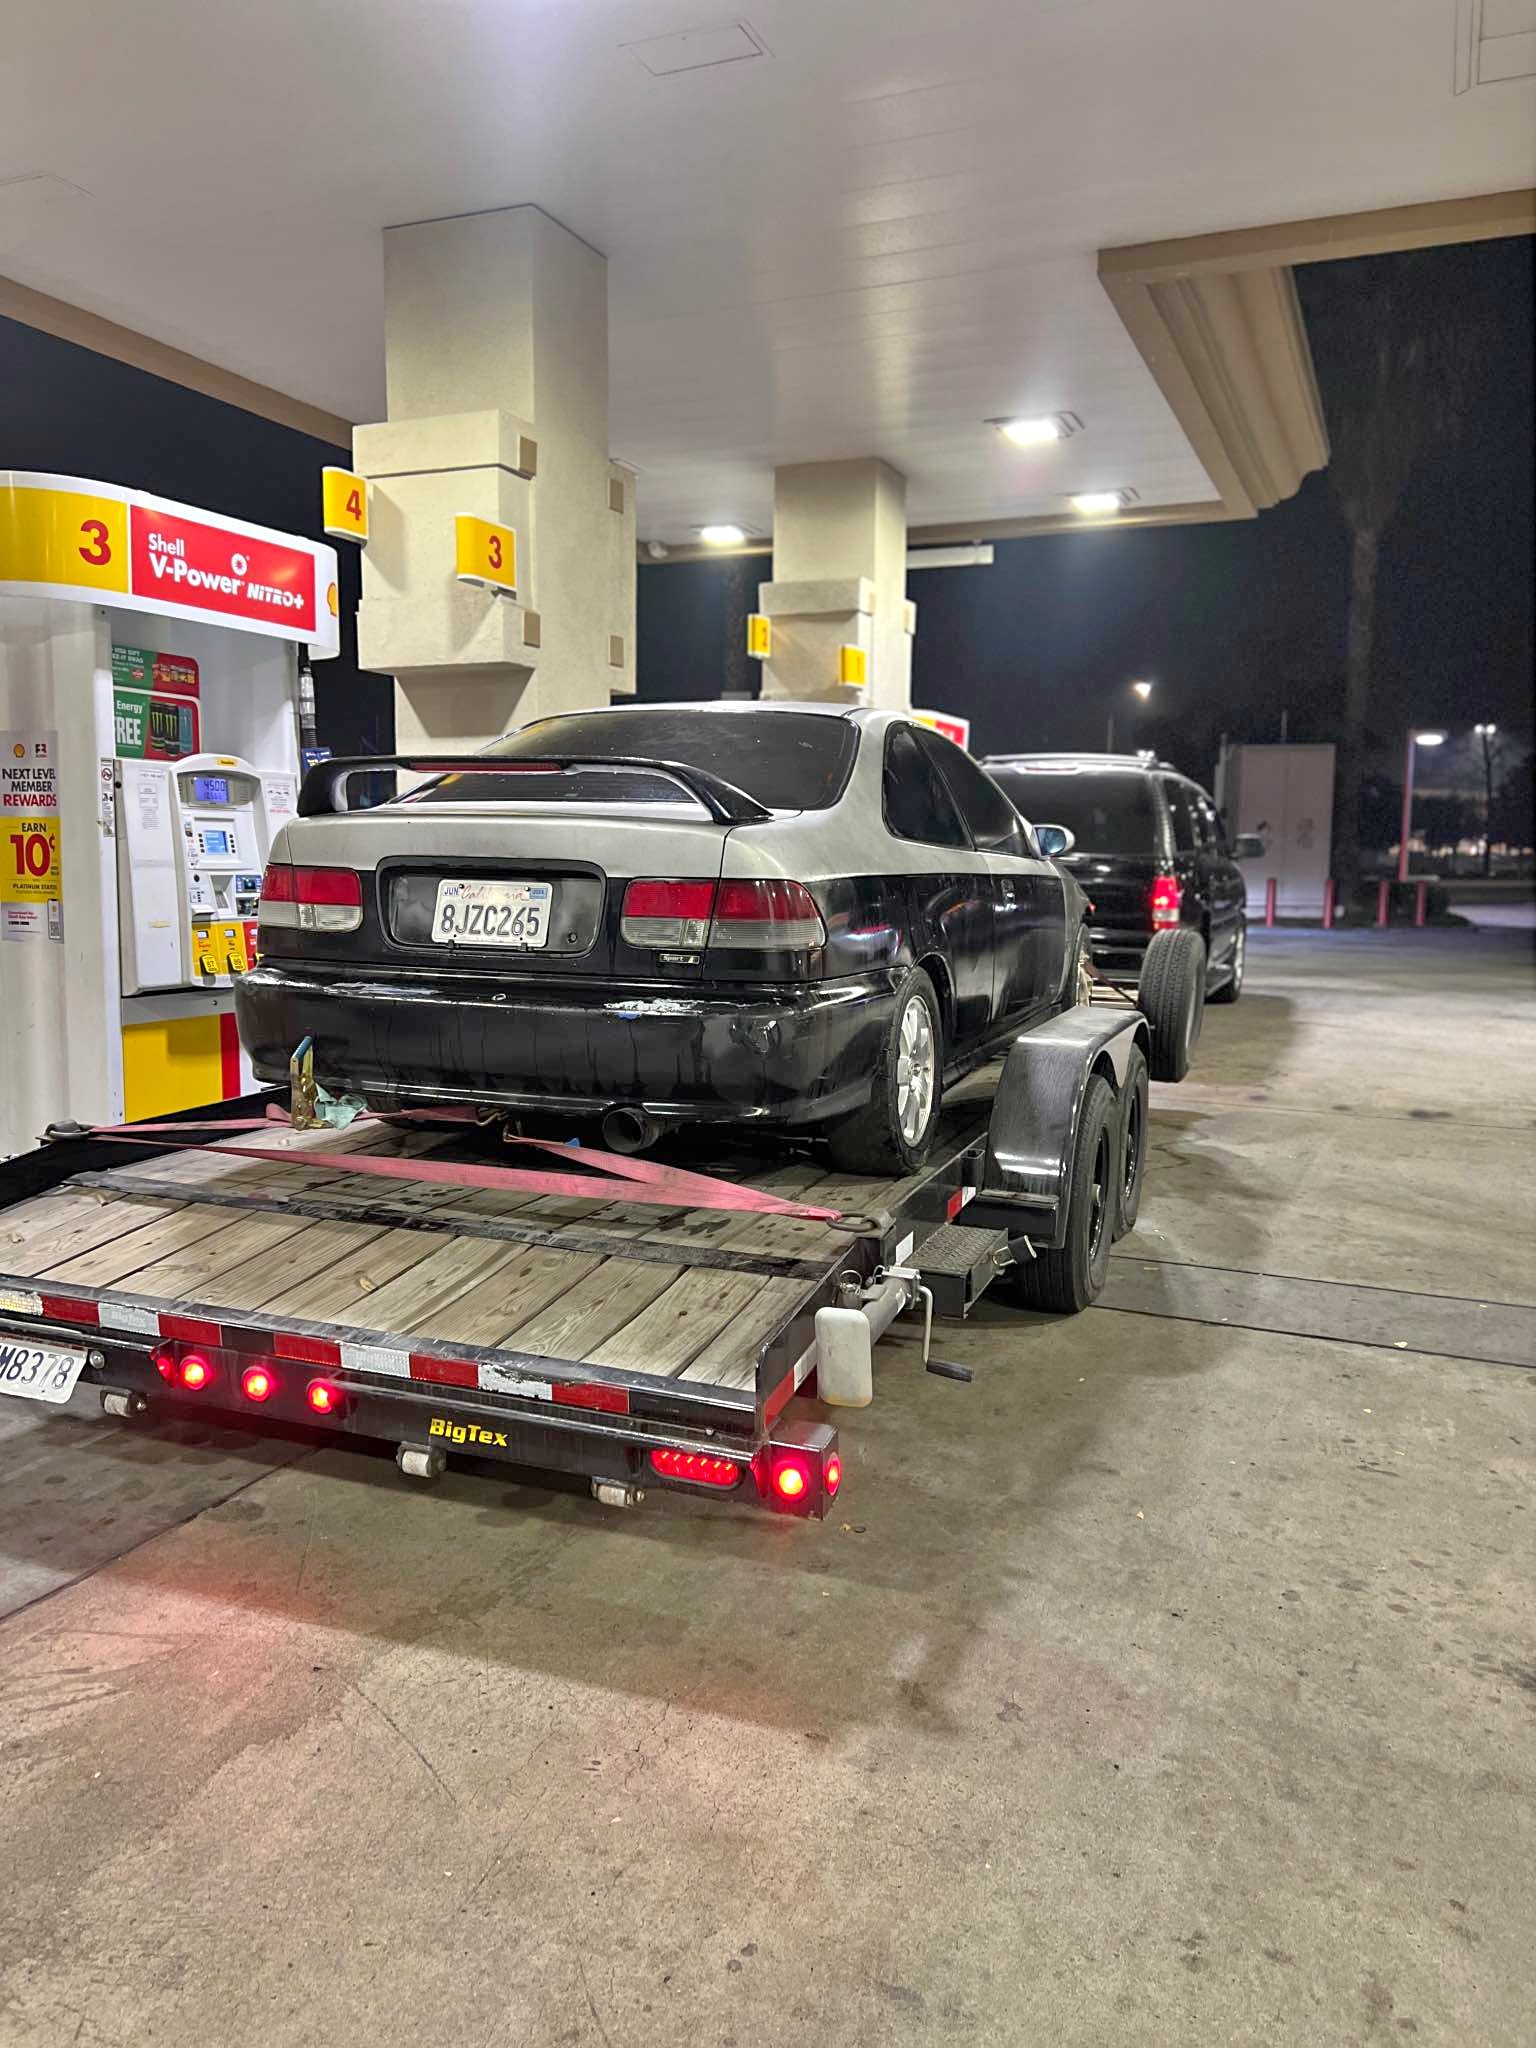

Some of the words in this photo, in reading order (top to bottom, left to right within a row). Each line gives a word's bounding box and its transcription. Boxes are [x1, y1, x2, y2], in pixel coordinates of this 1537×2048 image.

[346, 490, 362, 521] 4
[79, 519, 111, 565] 3
[148, 533, 185, 557] Shell
[487, 534, 502, 569] 3
[149, 553, 241, 595] V-Power
[116, 700, 142, 714] Energy
[2, 768, 31, 780] NEXT
[32, 768, 56, 780] LEVEL
[11, 781, 53, 792] MEMBER
[3, 793, 57, 807] REWARDS
[21, 823, 47, 832] EARN
[444, 886, 459, 896] JUN
[441, 903, 541, 937] 8JZC265
[0, 1345, 75, 1390] M8378
[429, 1417, 508, 1447] BigTex
